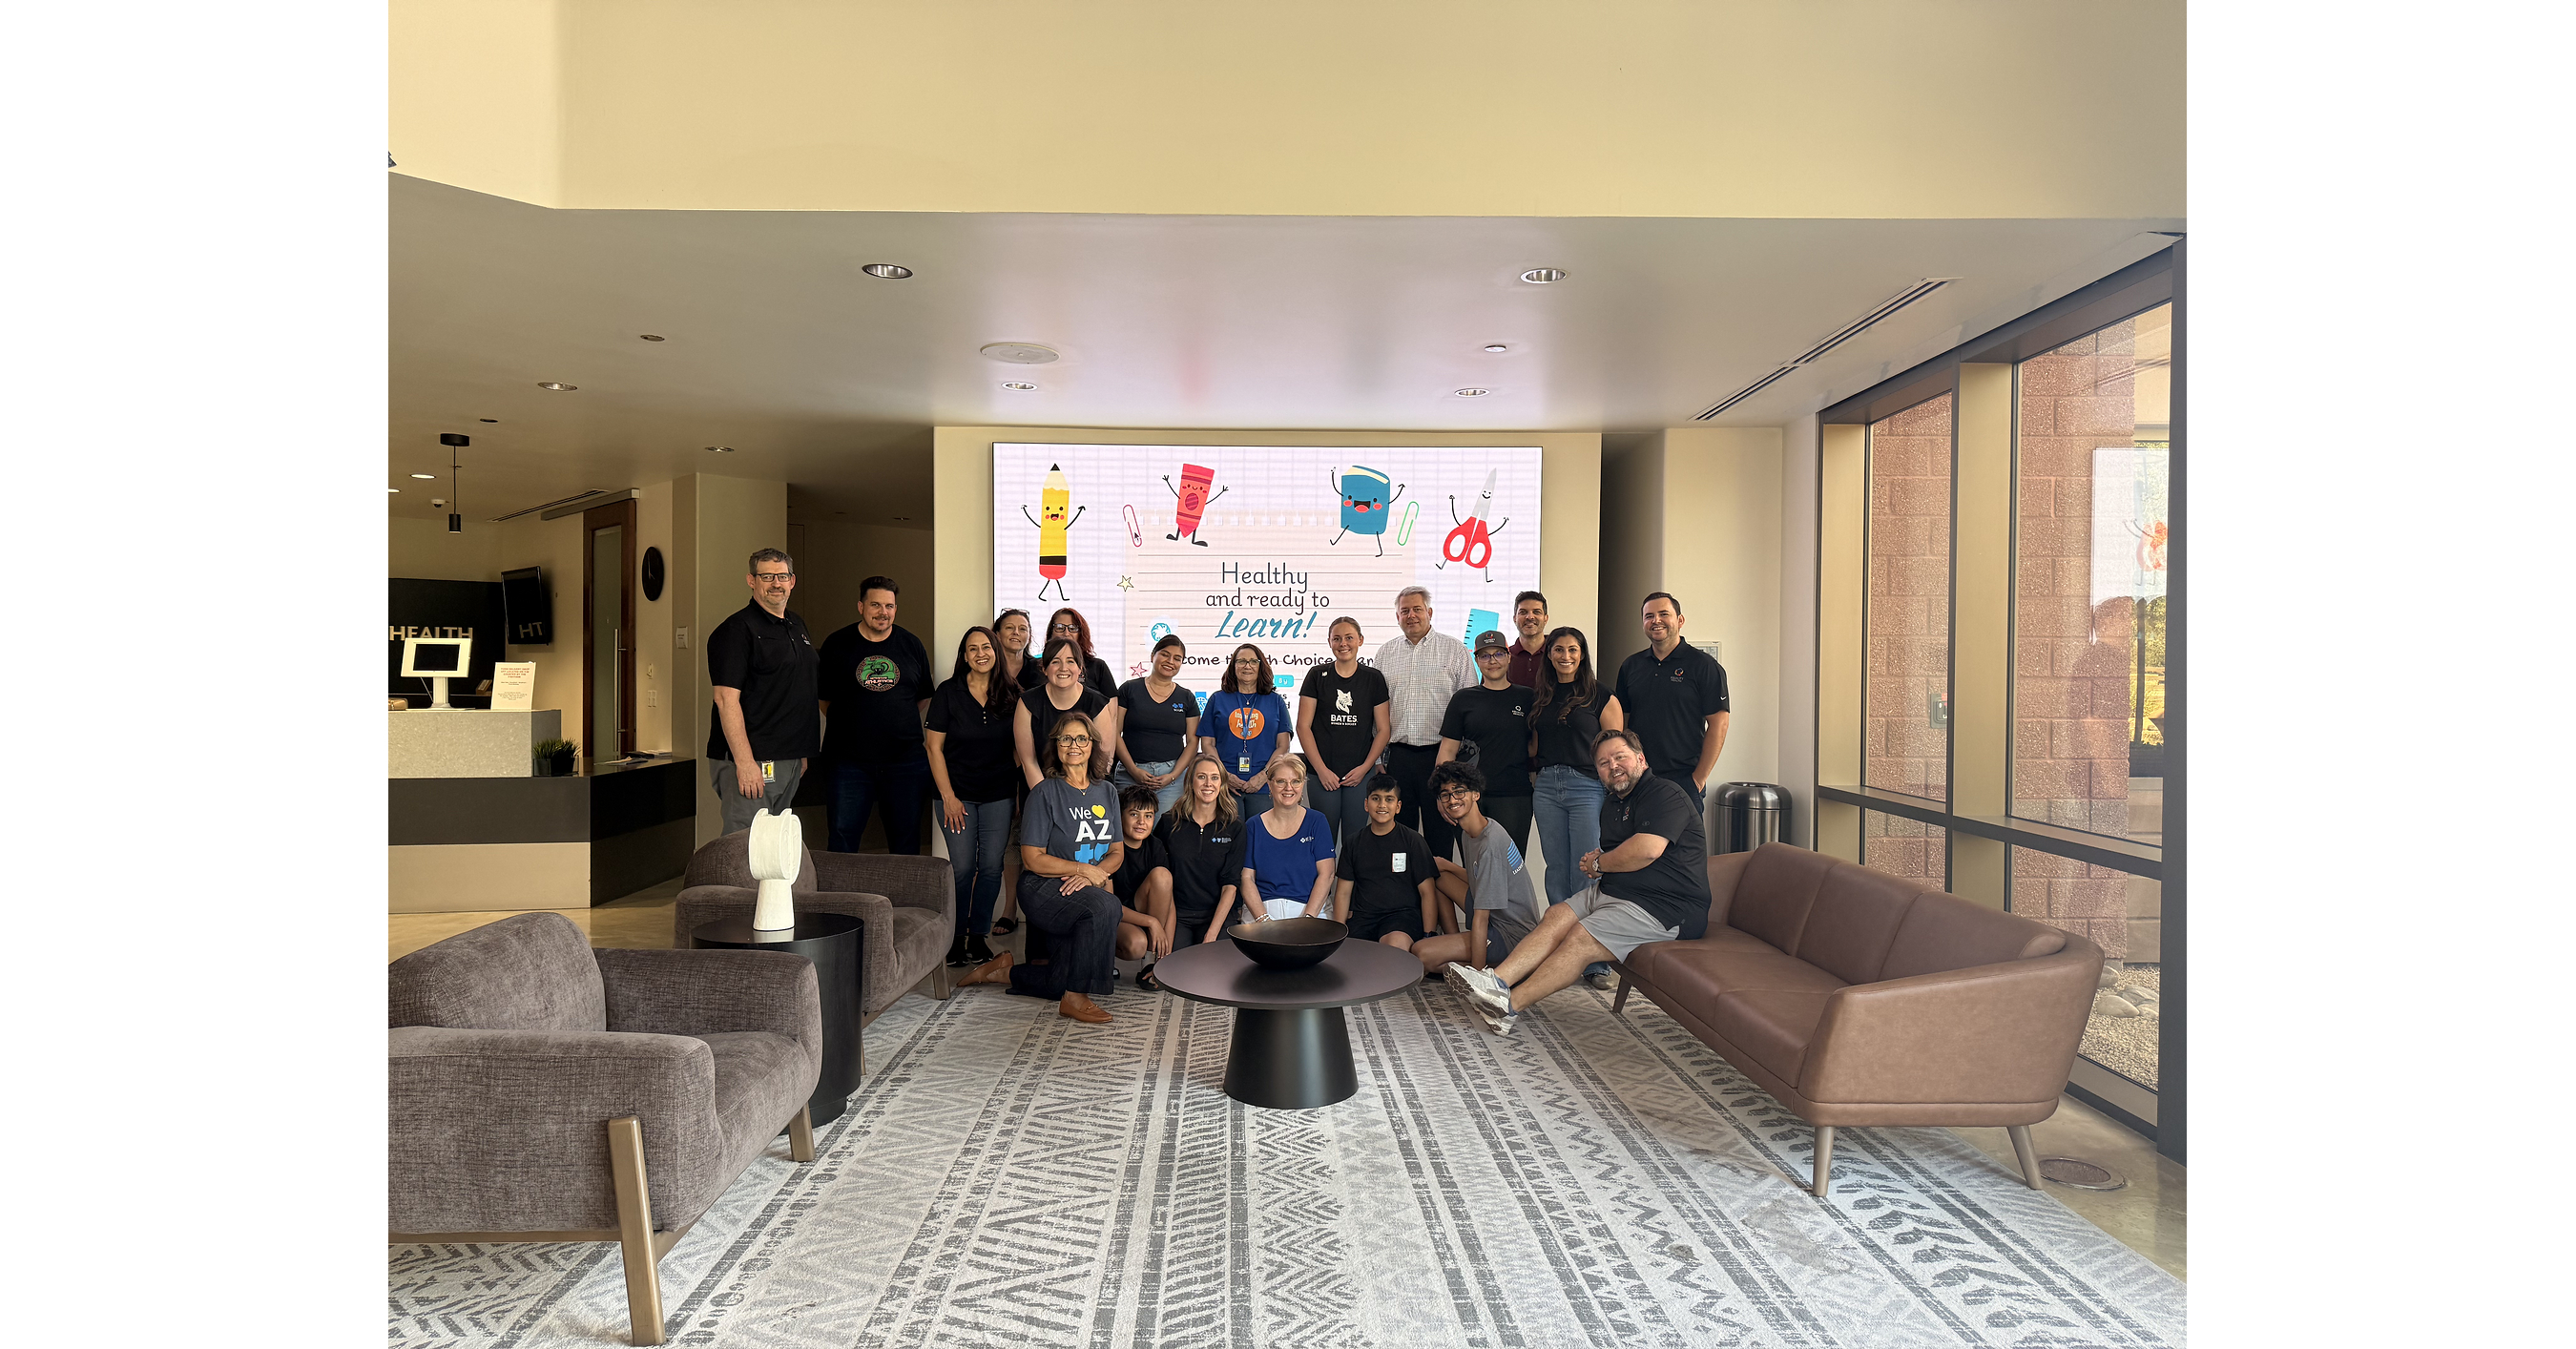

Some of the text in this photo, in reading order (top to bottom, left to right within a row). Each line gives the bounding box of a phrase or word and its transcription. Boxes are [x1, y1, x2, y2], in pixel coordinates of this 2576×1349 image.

[1222, 561, 1308, 593] Healthy
[1206, 587, 1330, 615] and ready to
[1215, 610, 1318, 638] Learn!
[1181, 654, 1220, 666] come
[1330, 714, 1357, 723] BATES
[1069, 806, 1092, 820] We
[1074, 820, 1112, 842] AZ
